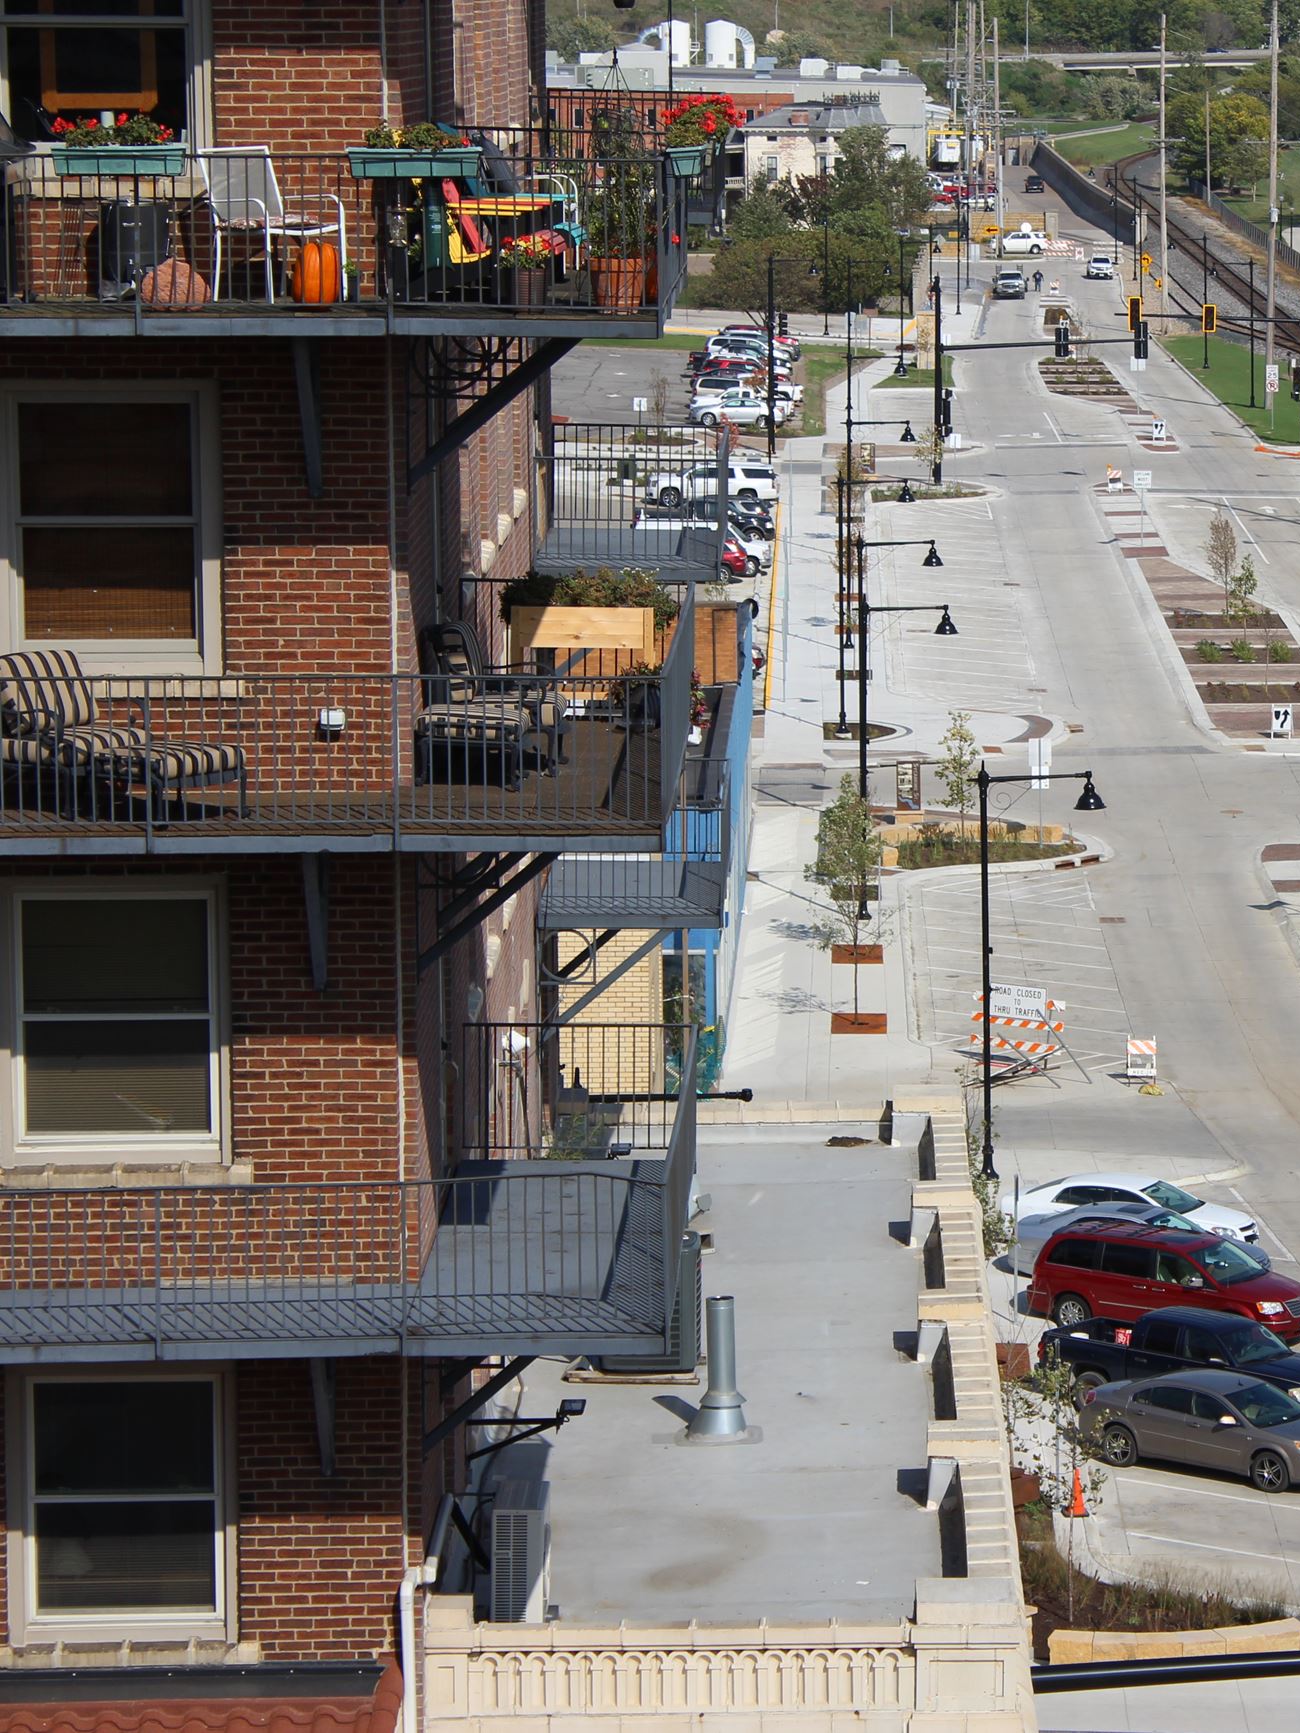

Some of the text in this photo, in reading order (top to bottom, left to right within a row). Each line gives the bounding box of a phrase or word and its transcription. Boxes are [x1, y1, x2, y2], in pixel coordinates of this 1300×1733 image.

[995, 985, 1042, 1000] ROAD CLOSED
[1014, 998, 1021, 1006] TO
[994, 1004, 1042, 1018] THRU TRAFFIC
